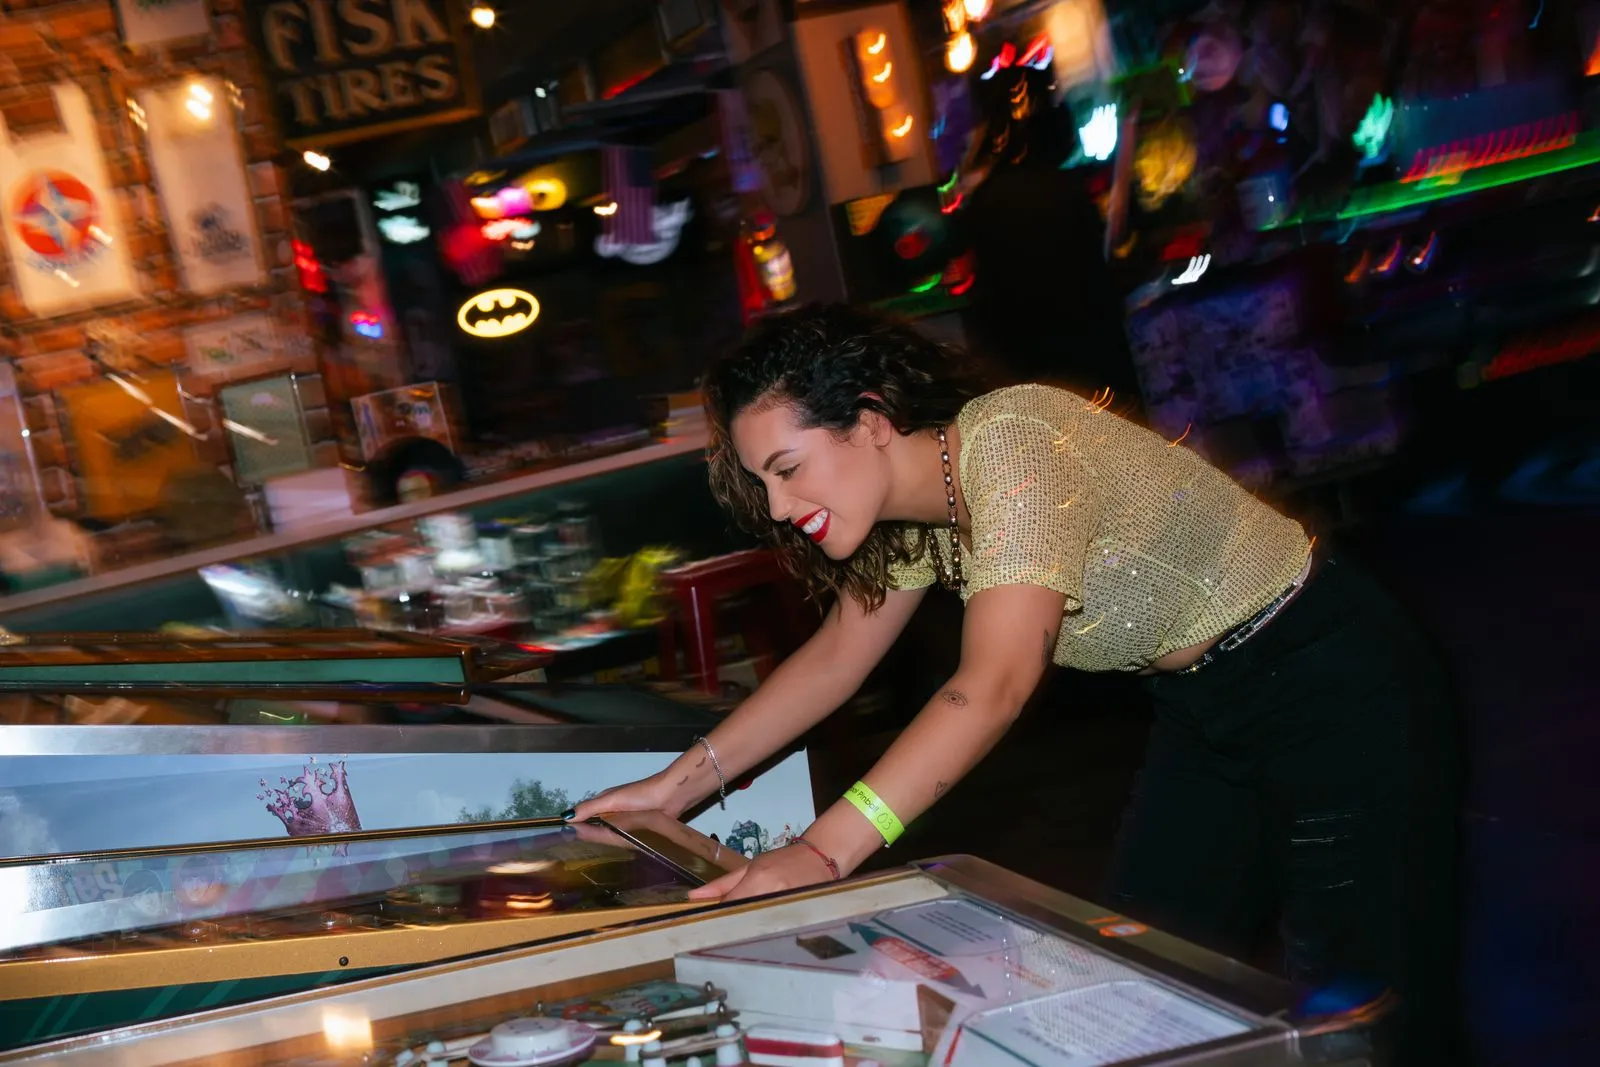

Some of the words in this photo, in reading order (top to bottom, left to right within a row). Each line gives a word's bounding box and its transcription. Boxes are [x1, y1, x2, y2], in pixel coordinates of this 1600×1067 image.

[263, 0, 450, 71] FISK
[278, 54, 458, 126] TIRES
[857, 790, 880, 813] Pinball
